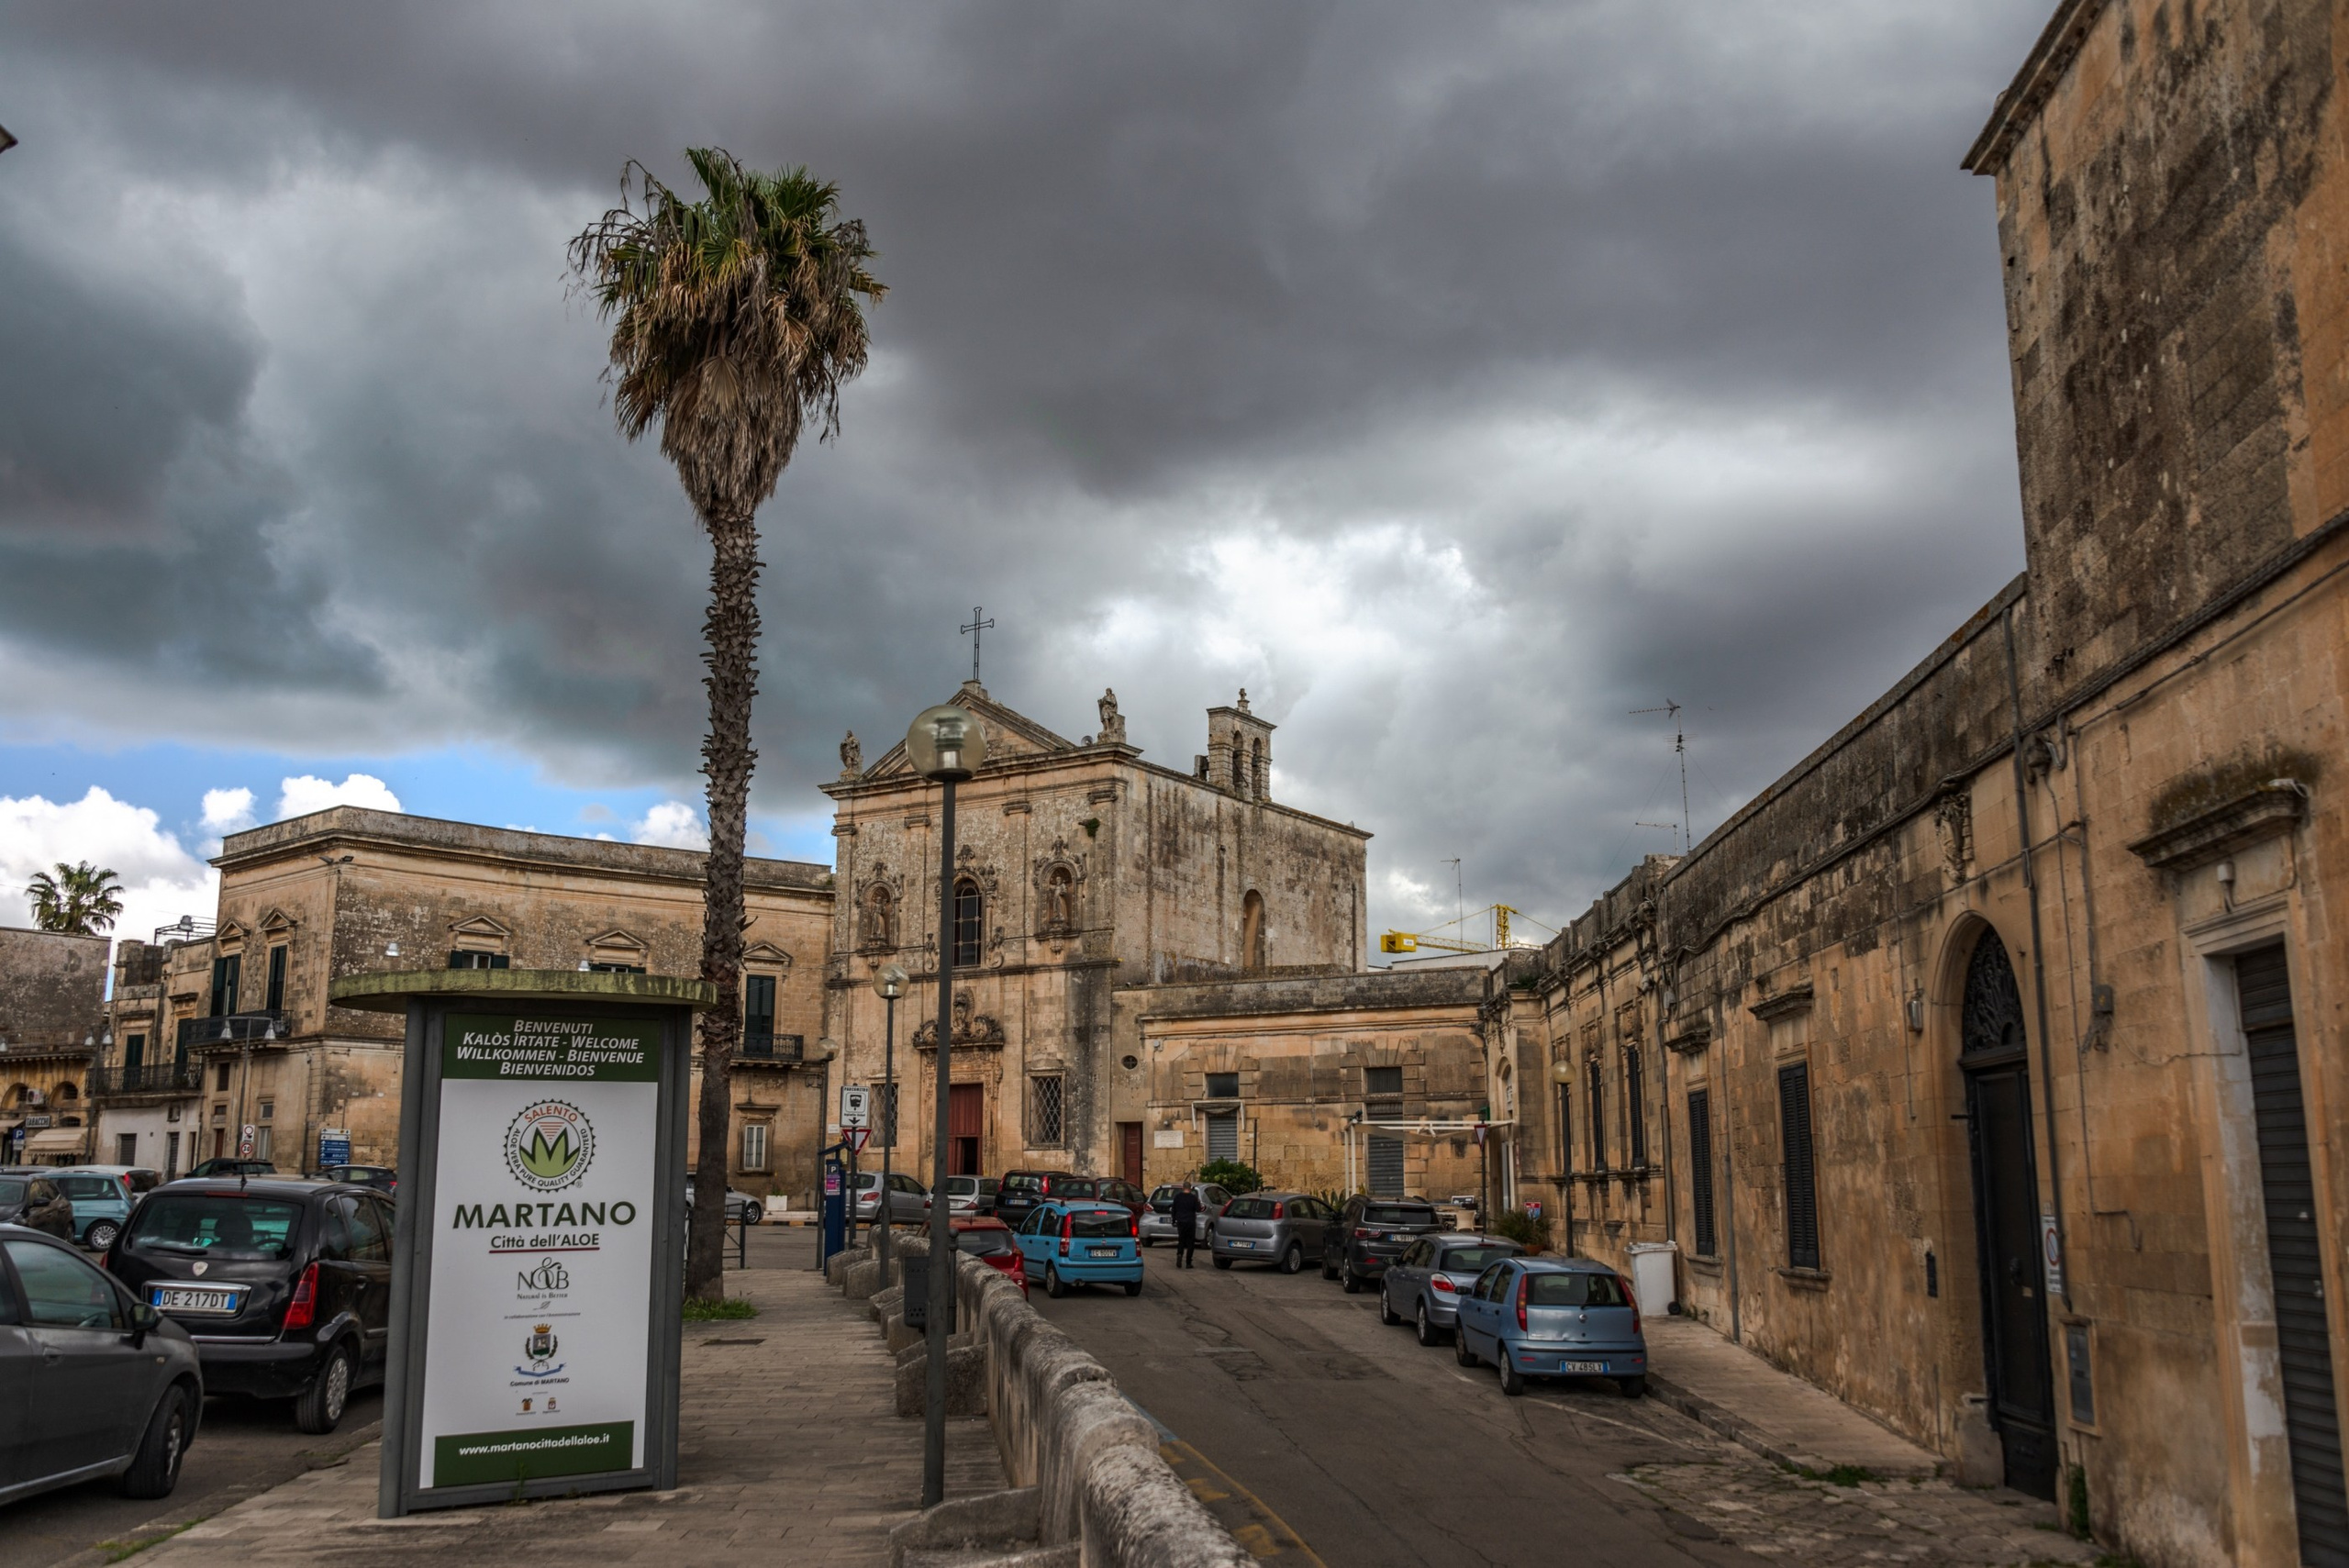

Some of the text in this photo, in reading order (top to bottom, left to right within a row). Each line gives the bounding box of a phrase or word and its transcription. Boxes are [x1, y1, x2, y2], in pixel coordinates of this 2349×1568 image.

[513, 1019, 594, 1035] BENVENUTI
[462, 1031, 511, 1046] KALÒS
[513, 1032, 561, 1048] ÌRTATE
[571, 1035, 640, 1050] WELCOME
[457, 1046, 557, 1062] WILLKOMMEN
[567, 1049, 645, 1063] BIENVENUE
[500, 1062, 596, 1076] BIENVENIDOS
[27, 1117, 50, 1126] TABACCHI
[524, 1105, 578, 1123] SALENTO
[16, 1130, 24, 1139] P
[510, 1128, 590, 1187] ALOE VERA PURE QUALITY GUARANTEED
[452, 1200, 637, 1229] MARTANO
[490, 1233, 600, 1249] Città dell'ALOE
[162, 1291, 228, 1307] DE 217DT
[1565, 1362, 1576, 1372] CV
[459, 1432, 610, 1456] www.martanocittadellaloe.it
